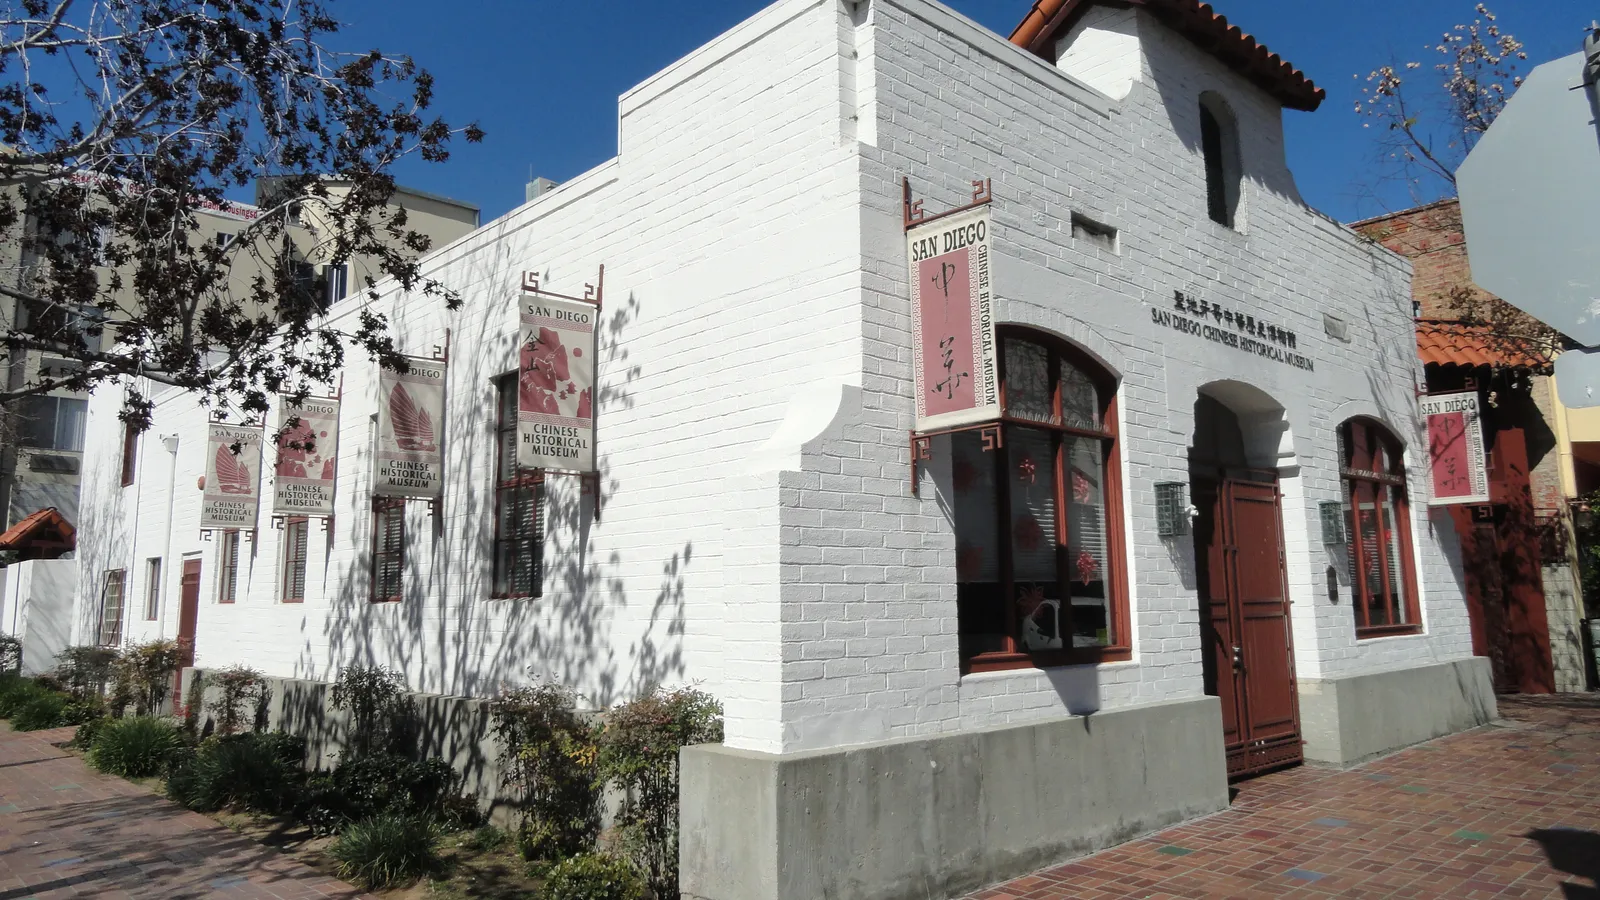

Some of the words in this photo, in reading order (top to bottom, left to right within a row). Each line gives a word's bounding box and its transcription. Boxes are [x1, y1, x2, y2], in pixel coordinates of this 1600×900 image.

[912, 235, 938, 262] SAN
[943, 219, 987, 253] DIEGO
[977, 244, 989, 290] CHINESE
[528, 304, 551, 318] SAN
[556, 309, 589, 324] DIEGO
[980, 292, 992, 355] HISTORICAL
[1151, 307, 1171, 328] SAN
[1172, 313, 1202, 338] DIEGO
[1203, 324, 1239, 349] CHINESE
[1239, 335, 1284, 364] HISTORICAL
[1284, 350, 1314, 372] MUSEUM
[411, 367, 440, 379] DIEGO
[983, 357, 997, 406] MUSEUM
[307, 405, 334, 414] DIEGO
[1421, 401, 1441, 415] SAN
[1444, 398, 1476, 413] DIEGO
[533, 423, 579, 438] CHINESE
[523, 432, 588, 449] HISTORICAL
[531, 445, 579, 458] MUSEUM
[389, 460, 430, 471] CHINESE
[380, 467, 437, 481] HISTORICAL
[286, 484, 322, 493] CHINESE
[387, 477, 429, 489] MUSEUM
[1476, 471, 1486, 496] MUSEUM
[278, 491, 329, 501] HISTORICAL
[284, 498, 322, 507] MUSEUM
[205, 507, 252, 516] HISTORICAL
[213, 501, 246, 509] CHINESE
[211, 514, 245, 522] MUSEUM
